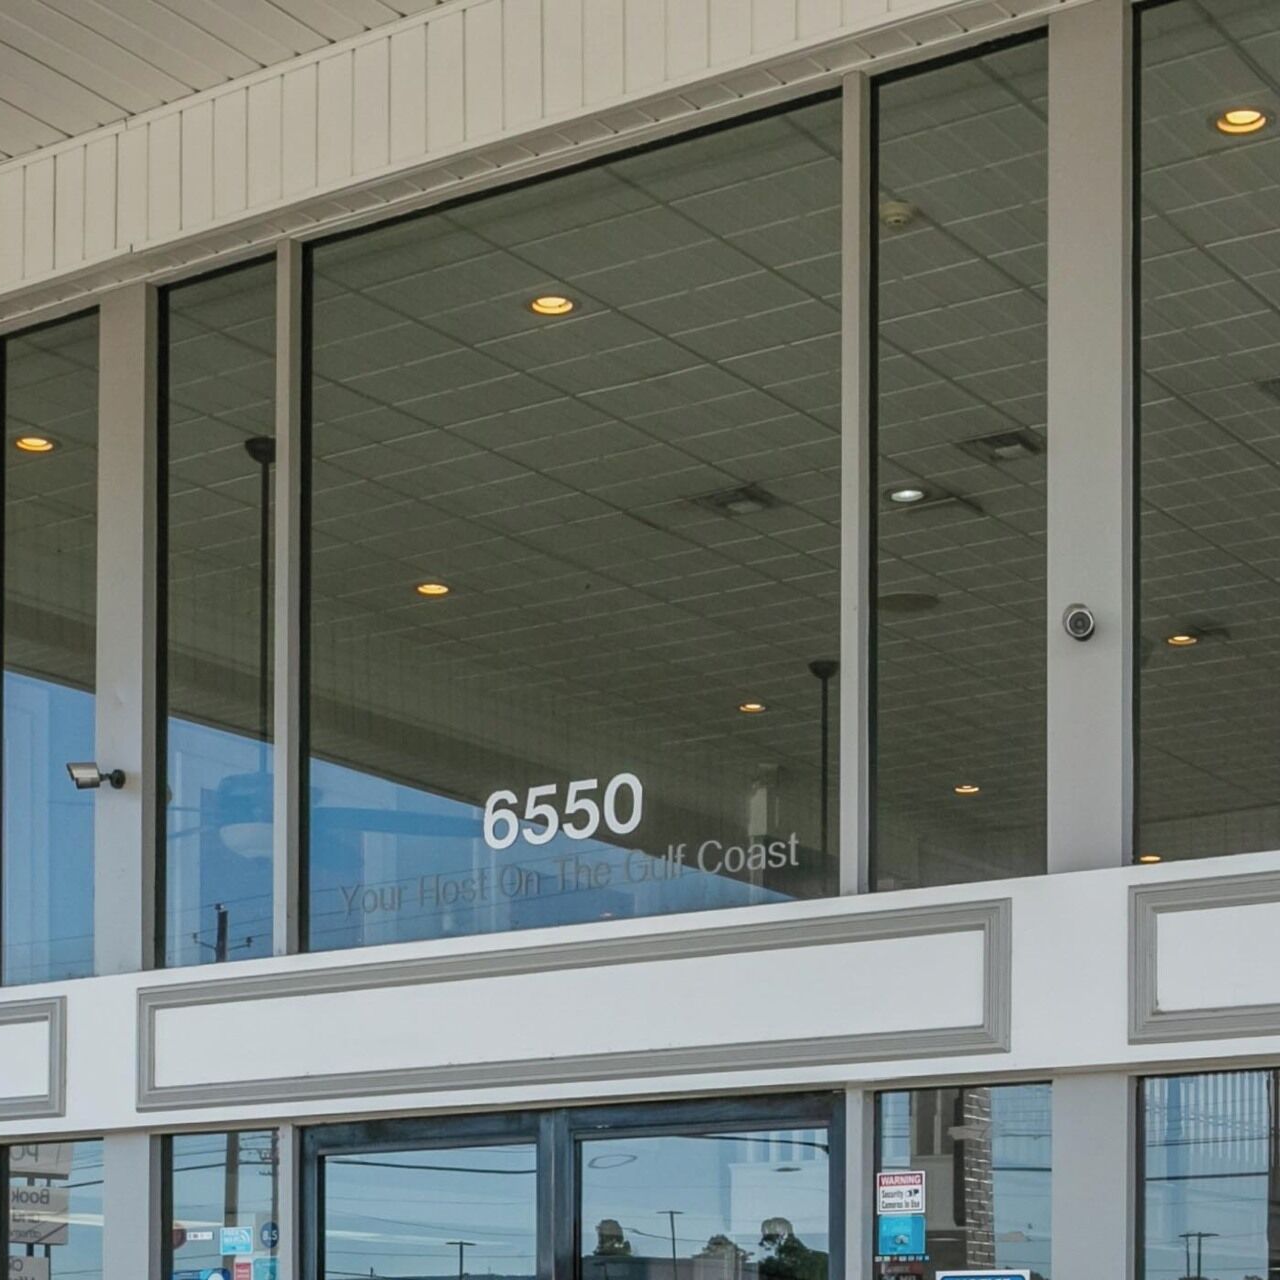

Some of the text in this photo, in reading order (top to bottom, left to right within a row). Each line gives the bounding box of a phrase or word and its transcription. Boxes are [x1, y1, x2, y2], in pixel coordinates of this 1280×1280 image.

[483, 773, 643, 849] 6550
[339, 832, 799, 918] Your Host On The Gulf Coast
[880, 1174, 921, 1186] WARNING
[261, 1230, 278, 1241] 8.5
